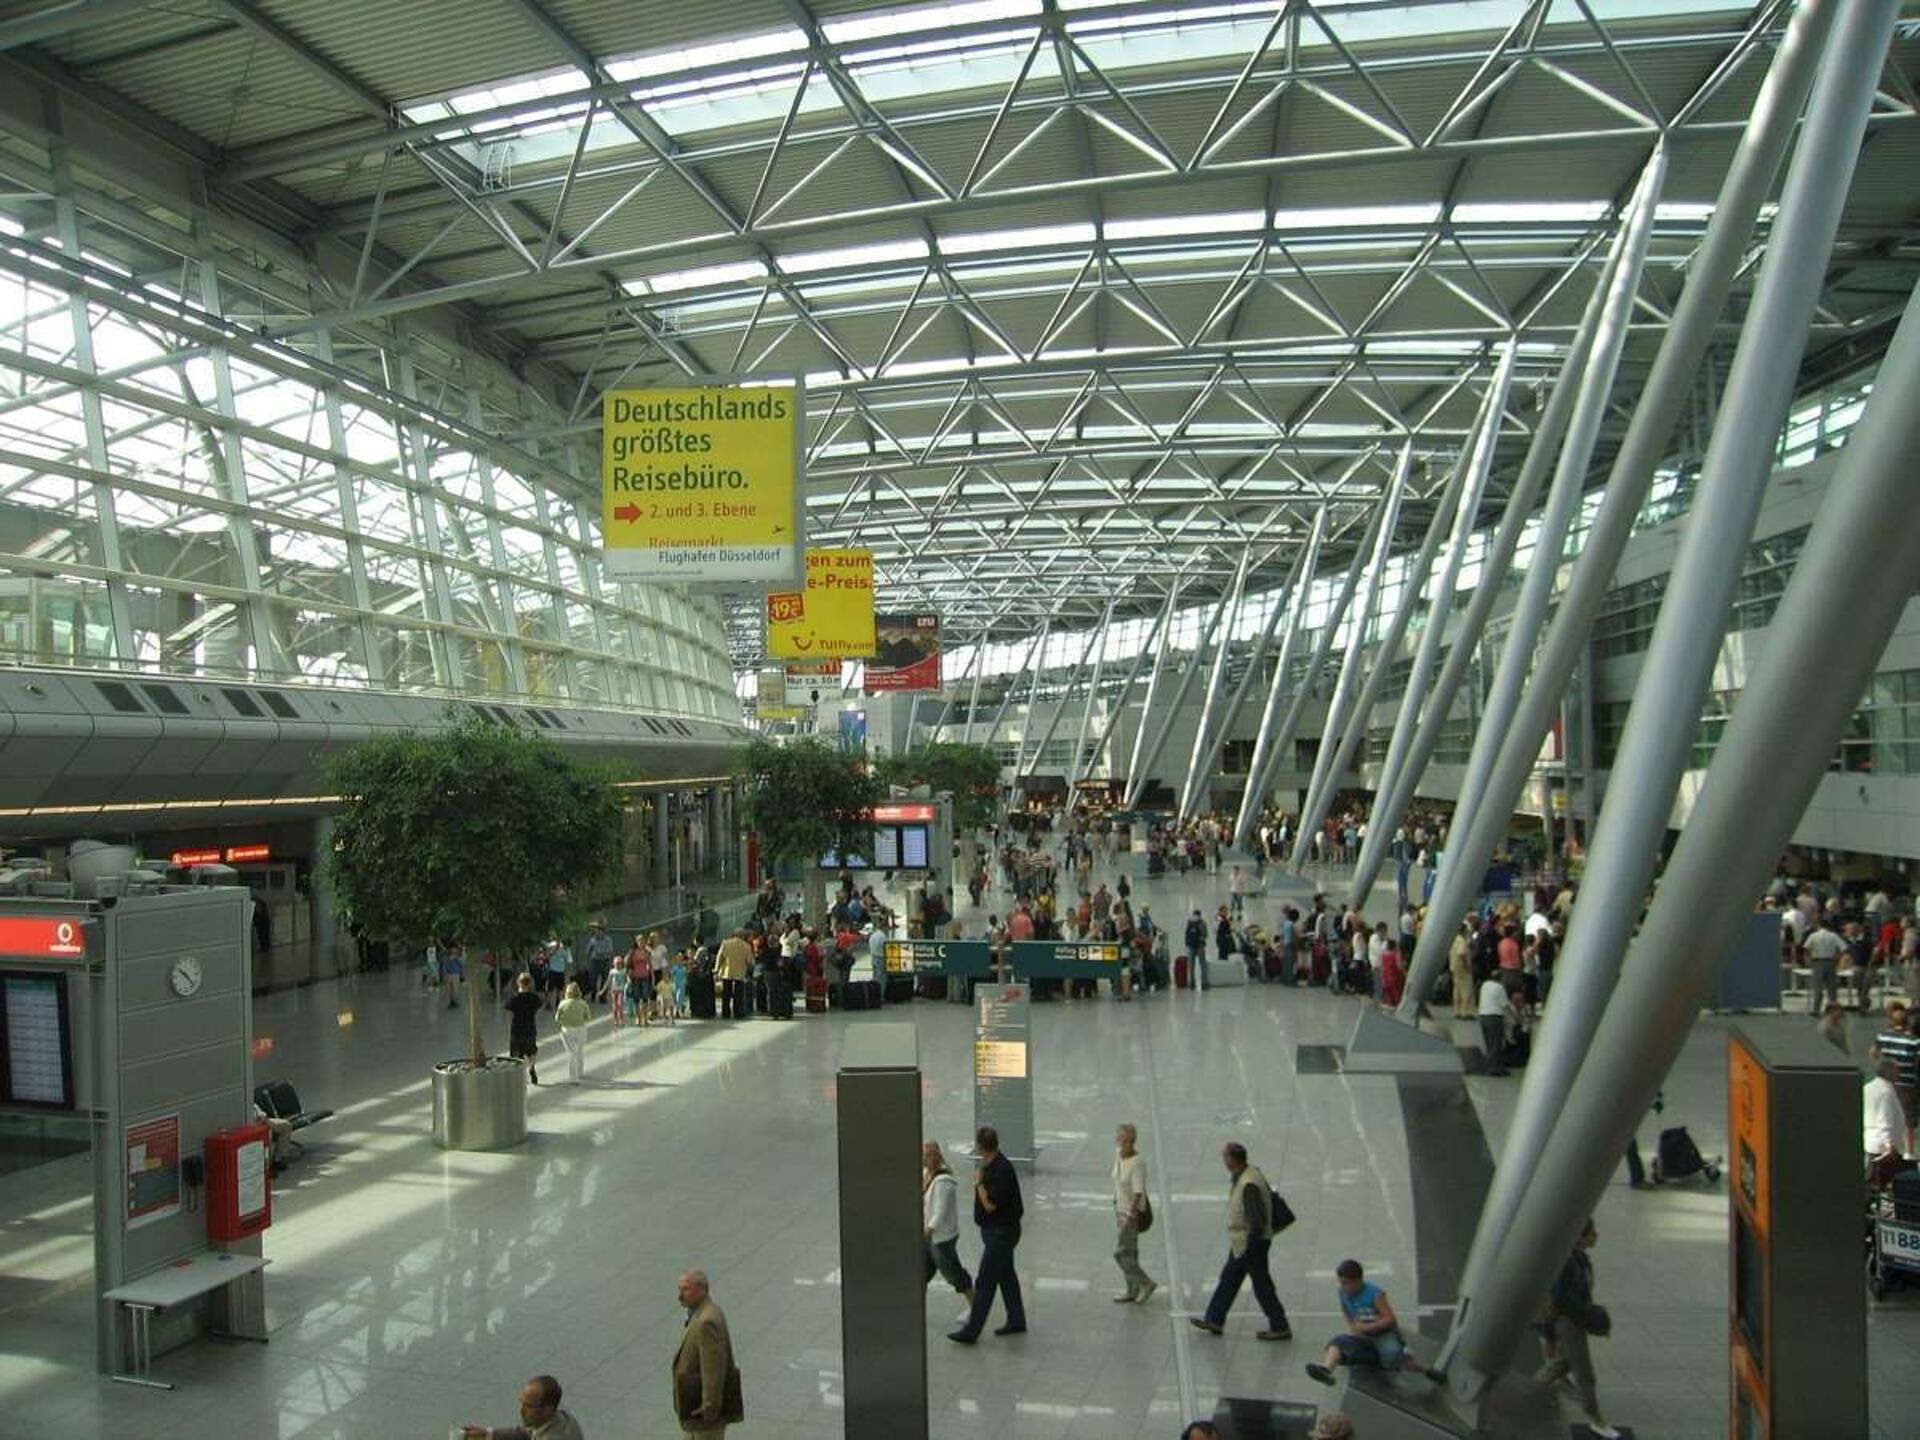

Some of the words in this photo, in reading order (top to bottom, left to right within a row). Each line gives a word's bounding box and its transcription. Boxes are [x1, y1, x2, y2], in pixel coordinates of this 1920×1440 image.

[613, 393, 787, 423] Deutschlands
[613, 427, 712, 461] größtes
[614, 464, 749, 491] Reisebüro.
[650, 504, 663, 519] 2.
[666, 503, 692, 518] und
[697, 503, 709, 518] 3.
[713, 502, 757, 517] Ebene
[658, 550, 716, 566] Flughafen
[719, 548, 782, 562] Düsseldorf
[838, 555, 871, 568] zum
